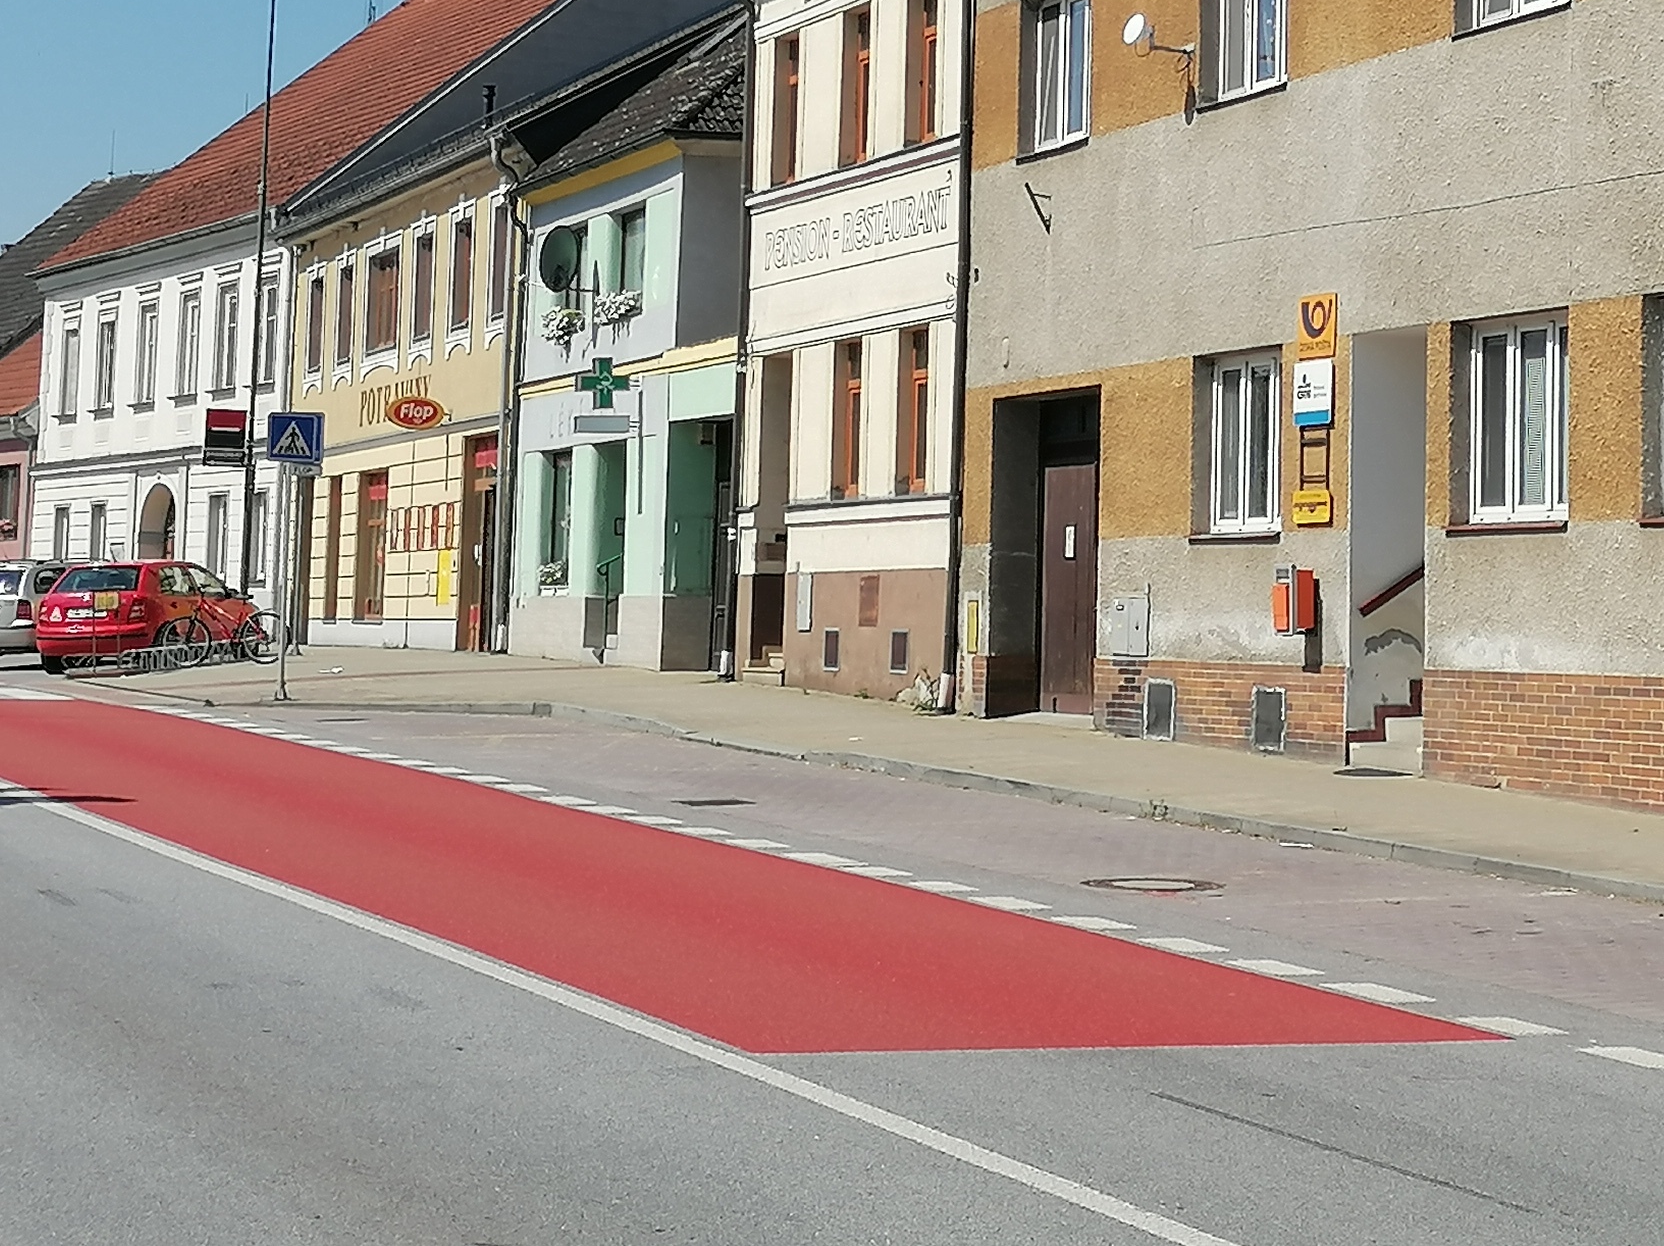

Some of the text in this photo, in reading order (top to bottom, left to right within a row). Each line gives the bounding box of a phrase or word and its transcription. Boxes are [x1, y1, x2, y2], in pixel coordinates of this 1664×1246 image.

[764, 217, 831, 271] PENSION
[842, 185, 952, 253] RESTAURANT
[400, 402, 434, 420] Flop
